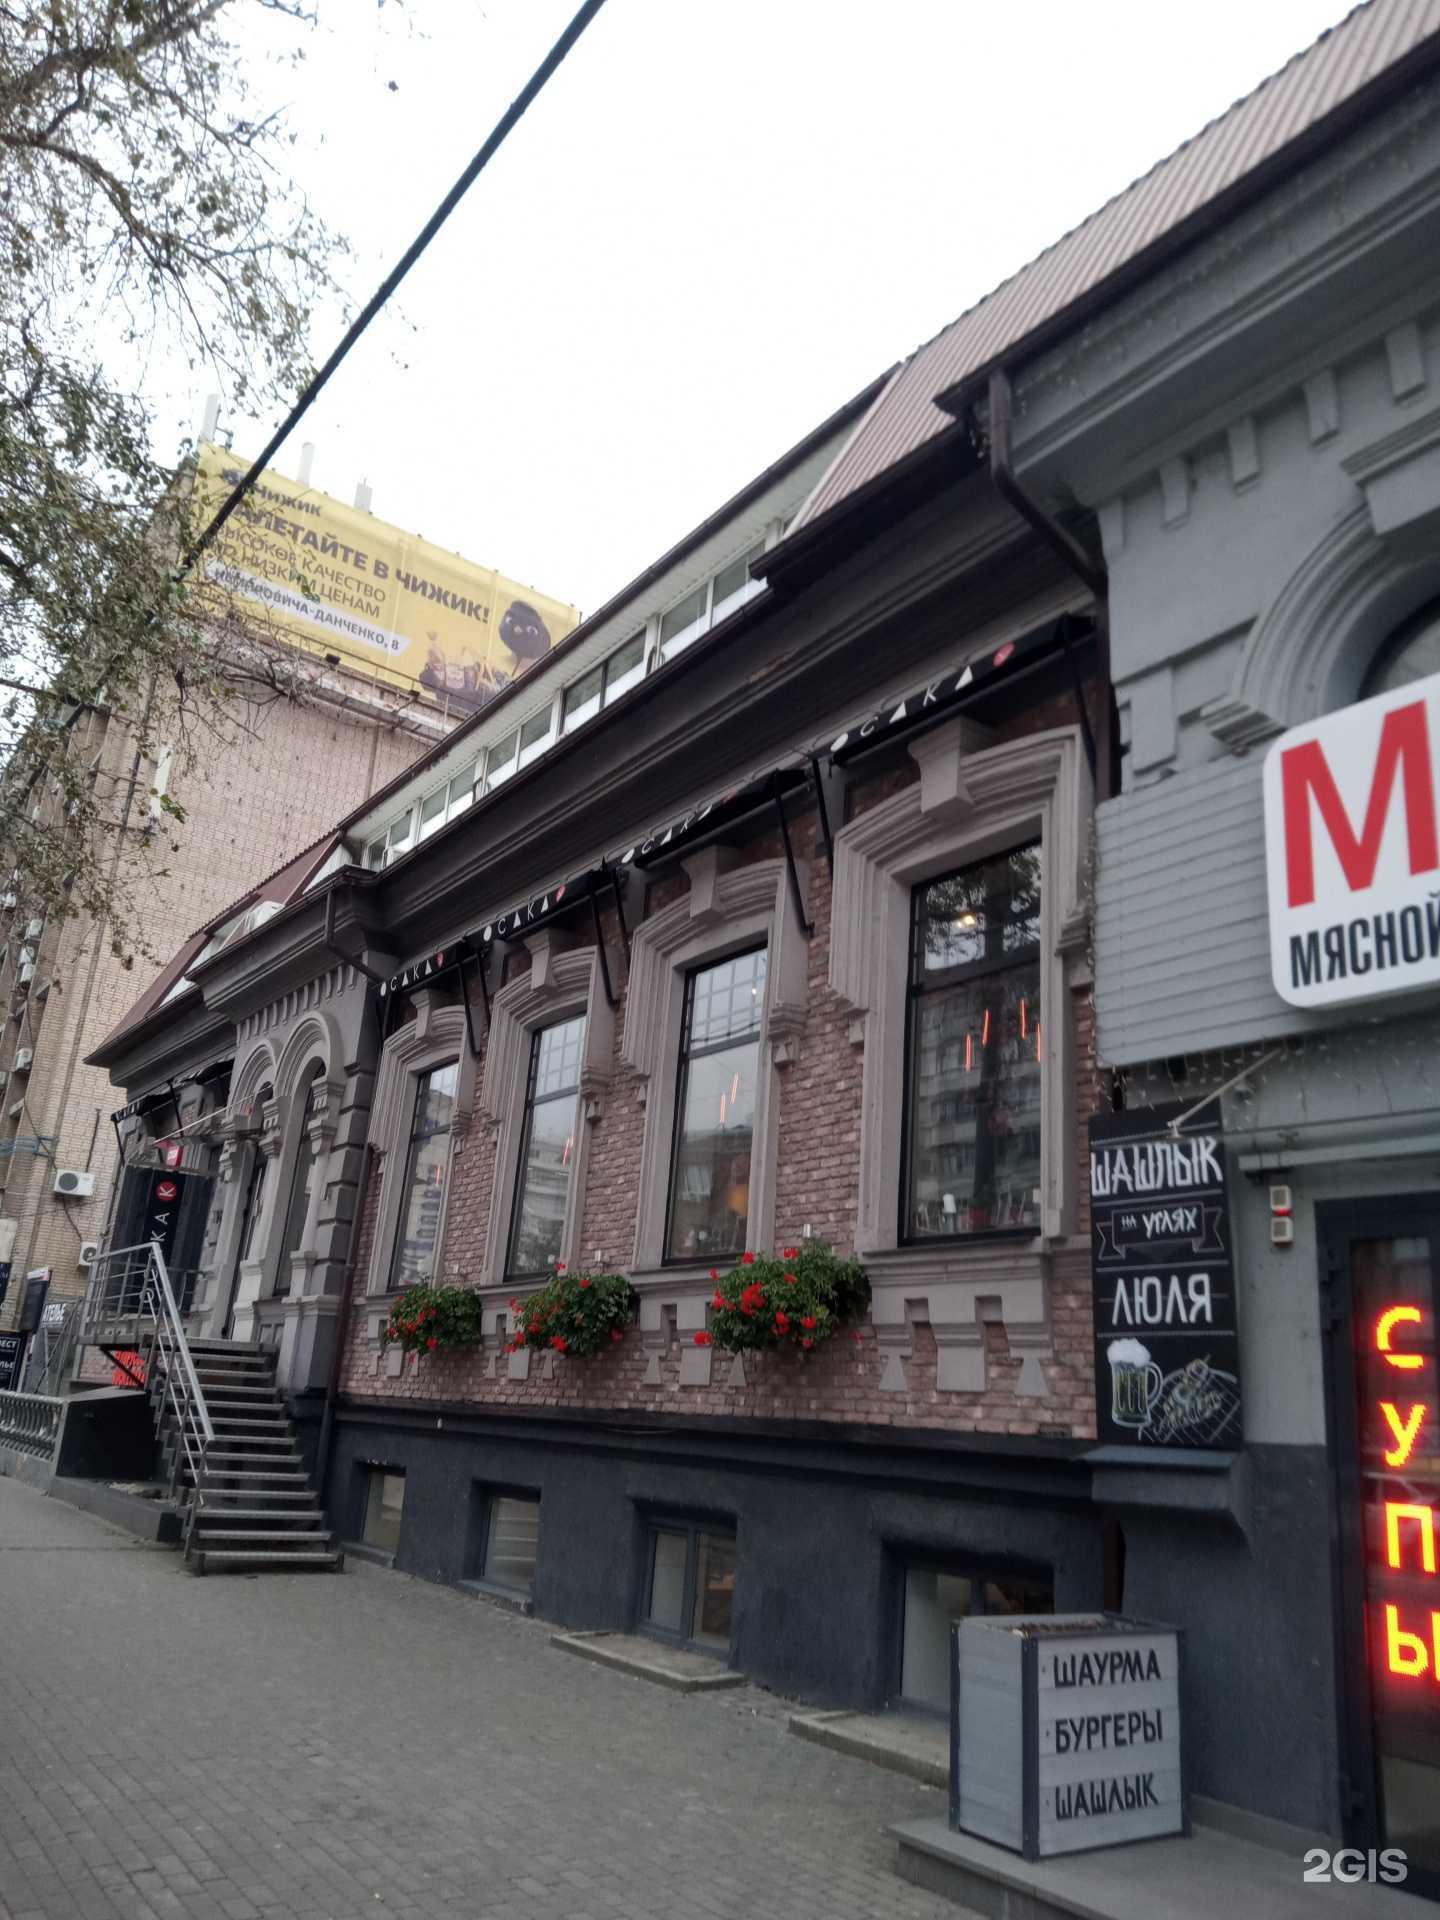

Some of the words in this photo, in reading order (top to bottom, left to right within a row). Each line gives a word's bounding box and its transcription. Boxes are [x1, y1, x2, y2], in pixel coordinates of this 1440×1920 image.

[222, 497, 369, 572] АЛЕТАЙТЕ
[374, 559, 389, 580] В
[396, 567, 490, 624] ЧИЖИК!
[302, 557, 386, 602] КАЧЕСТВО
[320, 582, 380, 619] ЦЕНАМ
[391, 639, 399, 651] 8
[1280, 698, 1439, 908] М
[1090, 1136, 1223, 1196] ШАШЛЫК
[1142, 1207, 1198, 1239] УГЛЯХ
[1111, 1273, 1213, 1326] ЛЮЛЯ
[1052, 1647, 1162, 1689] ШАУРМА
[1054, 1709, 1163, 1754] БУРГЕРЫ
[1054, 1772, 1159, 1822] ШАШЛЫК
